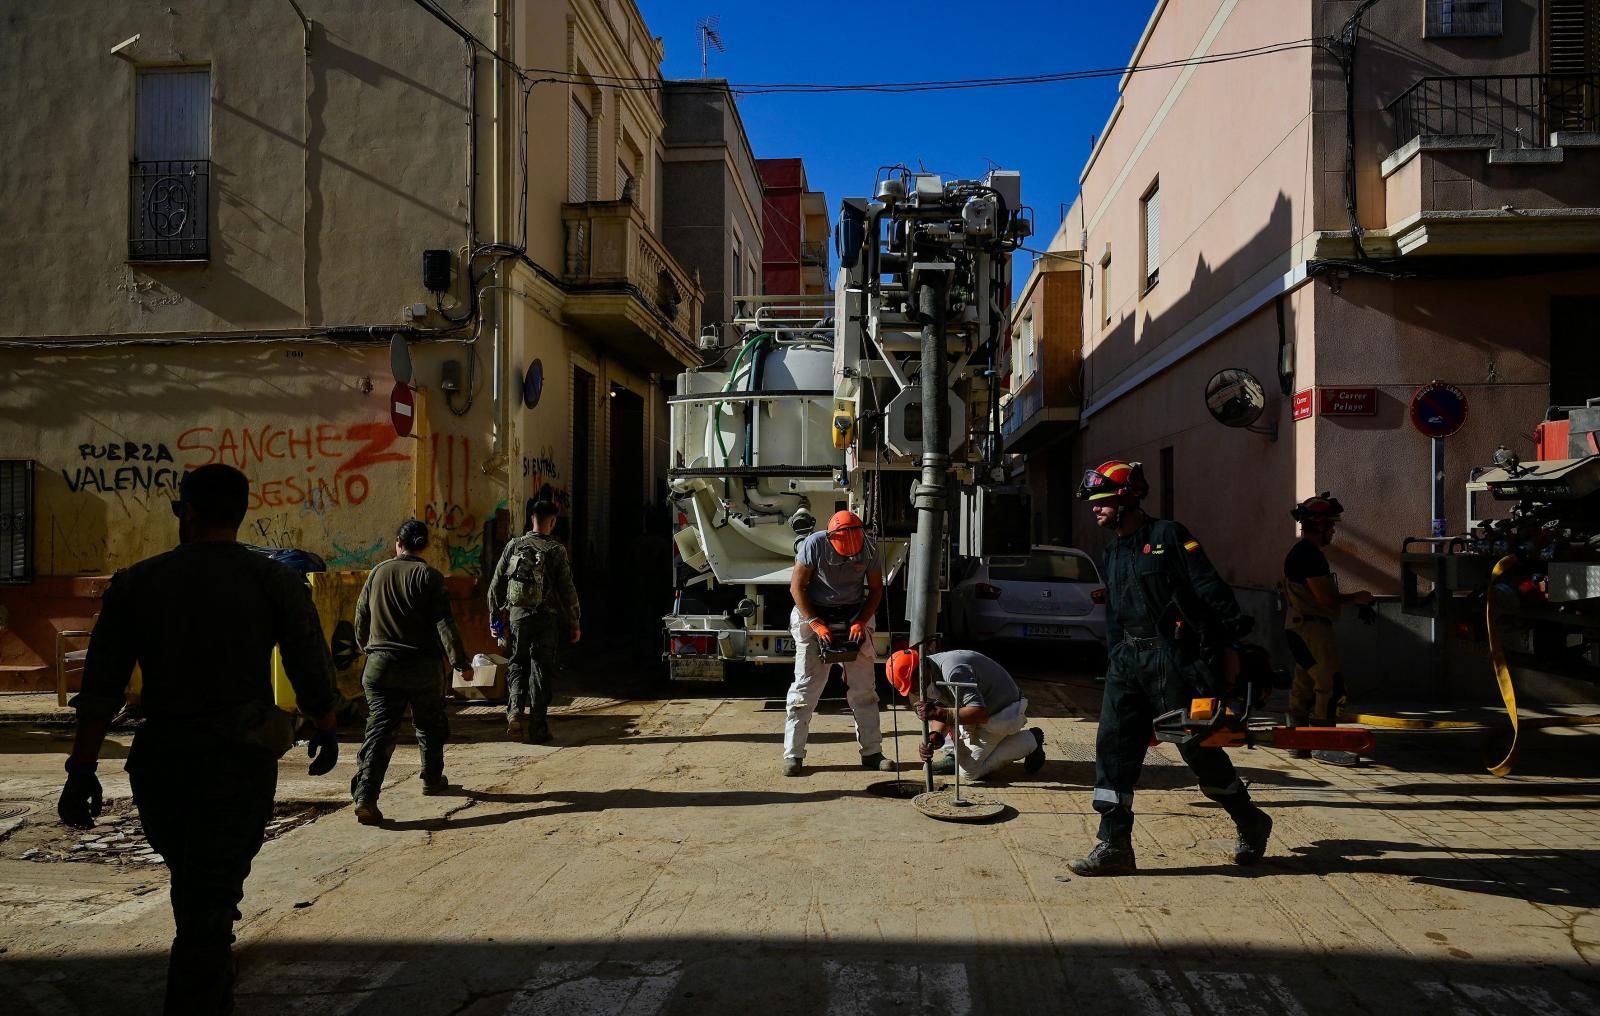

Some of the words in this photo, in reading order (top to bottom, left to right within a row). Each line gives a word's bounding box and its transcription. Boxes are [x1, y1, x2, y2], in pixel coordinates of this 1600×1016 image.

[1333, 402, 1363, 411] Pelayo
[79, 441, 174, 462] FUERZA
[177, 422, 411, 471] SANCHEZ
[247, 465, 370, 511] SESINO
